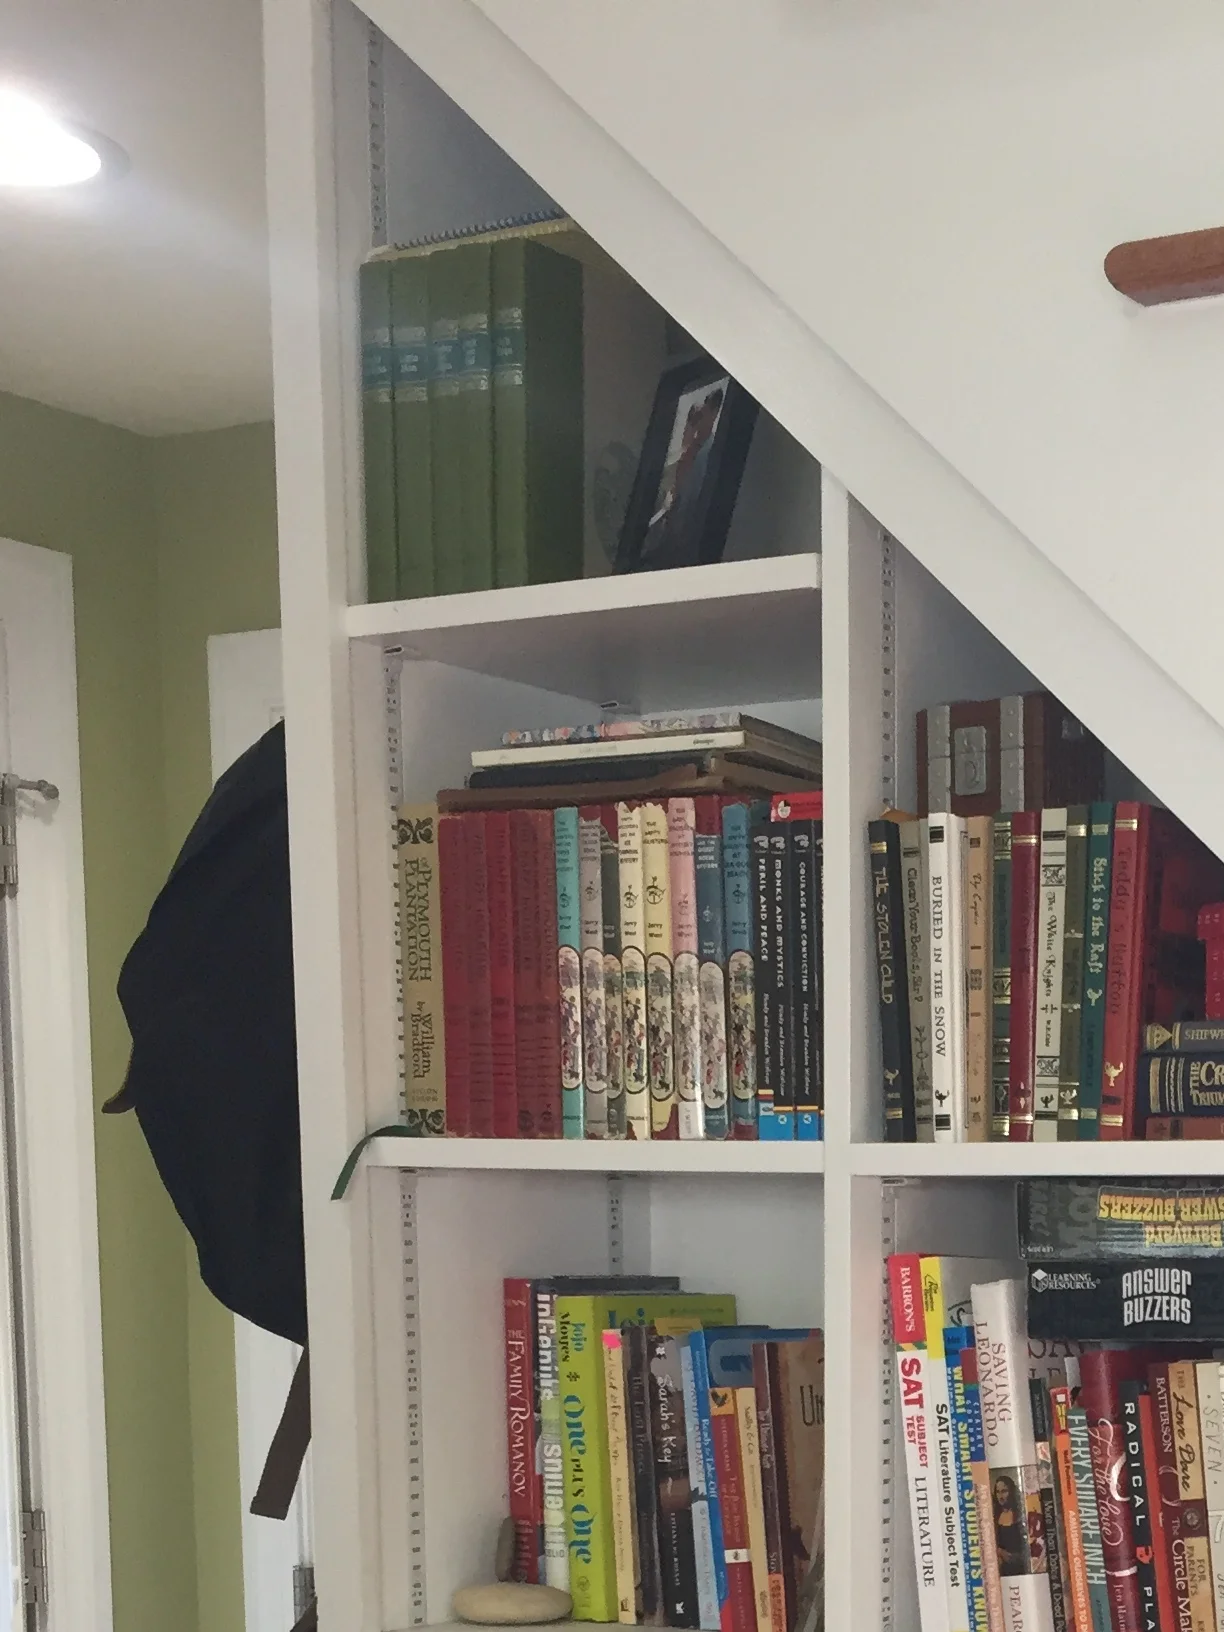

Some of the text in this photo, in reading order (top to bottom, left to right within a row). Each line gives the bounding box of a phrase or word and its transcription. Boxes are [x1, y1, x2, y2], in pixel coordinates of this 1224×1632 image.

[405, 858, 432, 982] PLYMOUTH PLANTATION
[931, 875, 946, 1057] BURIED IN THE SNOW
[1048, 1272, 1092, 1282] LEARNING
[1123, 1296, 1192, 1327] BUZZERS
[507, 1340, 532, 1498] FAMILY ROMANOV
[975, 1320, 1012, 1448] SAVING LEONARDO
[1155, 1376, 1173, 1453] BATTERSON
[657, 1435, 677, 1464] Key
[900, 1357, 936, 1588] SAT SUBJECT TEST LITERATURE
[935, 1403, 960, 1588] SAT Literature Subject Test
[1124, 1402, 1147, 1527] RADICAL
[1069, 1509, 1080, 1554] AMUSING
[1078, 1609, 1087, 1621] TO
[1170, 1539, 1187, 1591] Circle
